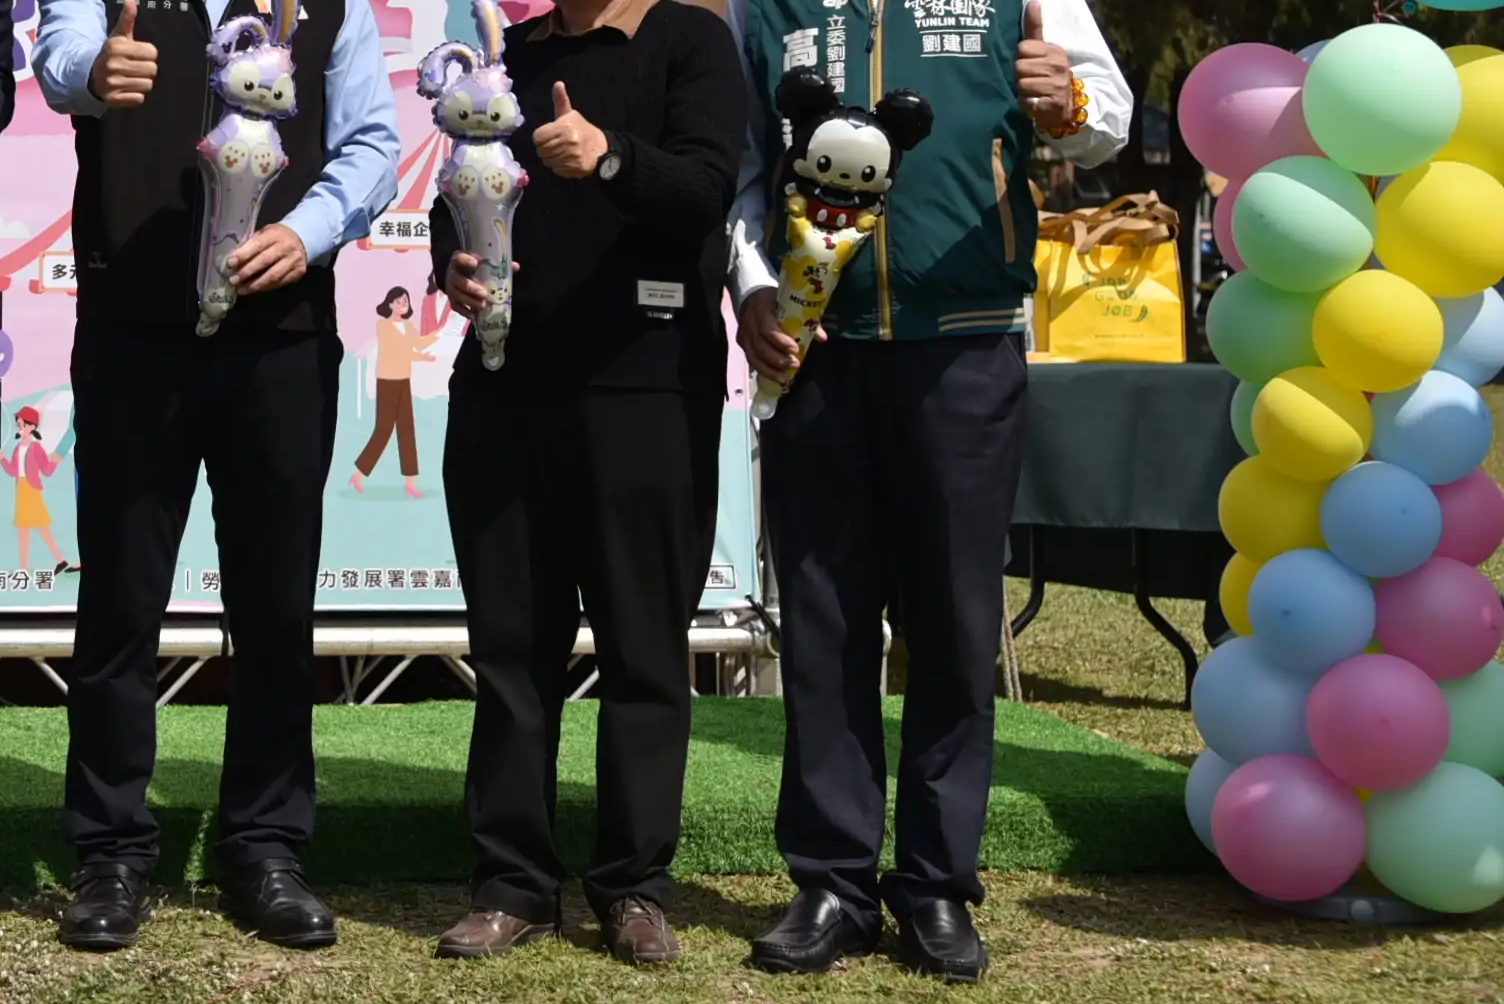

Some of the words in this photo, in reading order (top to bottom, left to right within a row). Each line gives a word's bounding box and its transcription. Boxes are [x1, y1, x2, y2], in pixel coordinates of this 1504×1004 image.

[915, 16, 956, 28] YUNLIN
[959, 16, 990, 28] TEAM
[922, 33, 982, 53] 劉建國
[379, 221, 429, 238] 幸福企
[318, 570, 460, 589] 力發展署雲嘉
